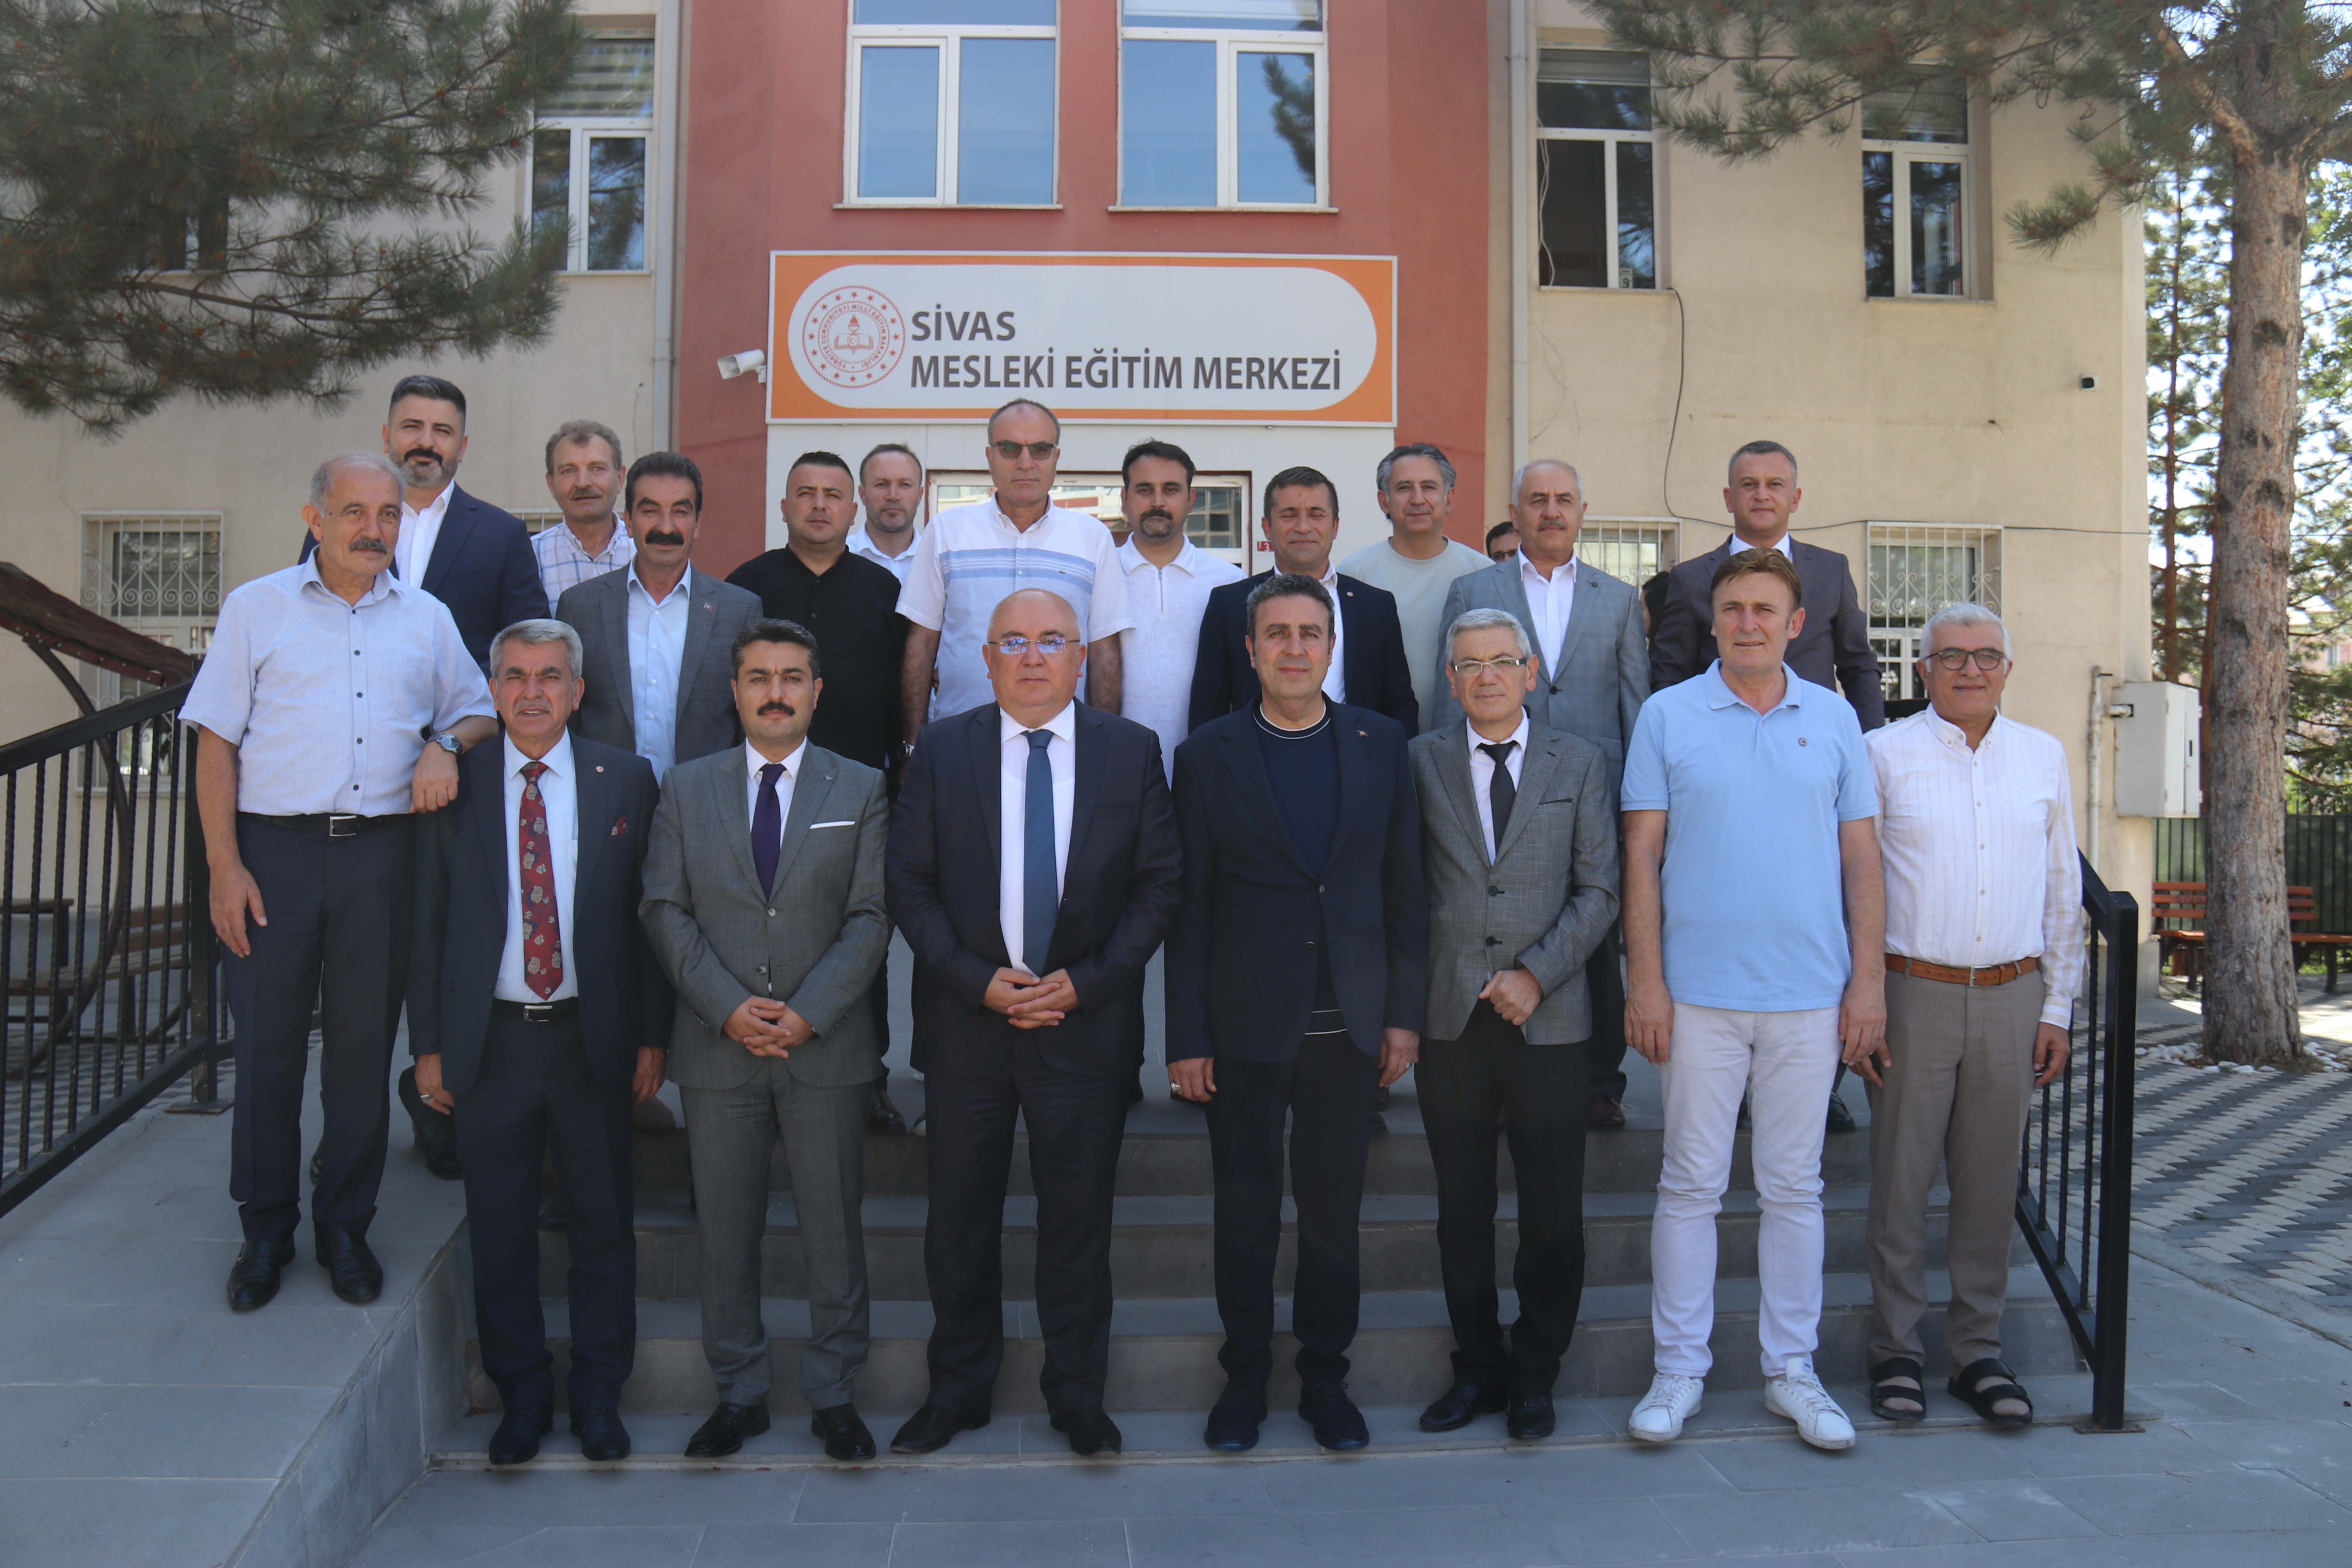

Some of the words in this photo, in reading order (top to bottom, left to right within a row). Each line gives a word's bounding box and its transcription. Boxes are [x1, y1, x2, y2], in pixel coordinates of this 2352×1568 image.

[911, 303, 1015, 341] SİVAS
[911, 347, 1054, 388] MESLEKİ
[1065, 347, 1182, 389] EĞİTİM
[1193, 349, 1339, 390] MERKEZİ
